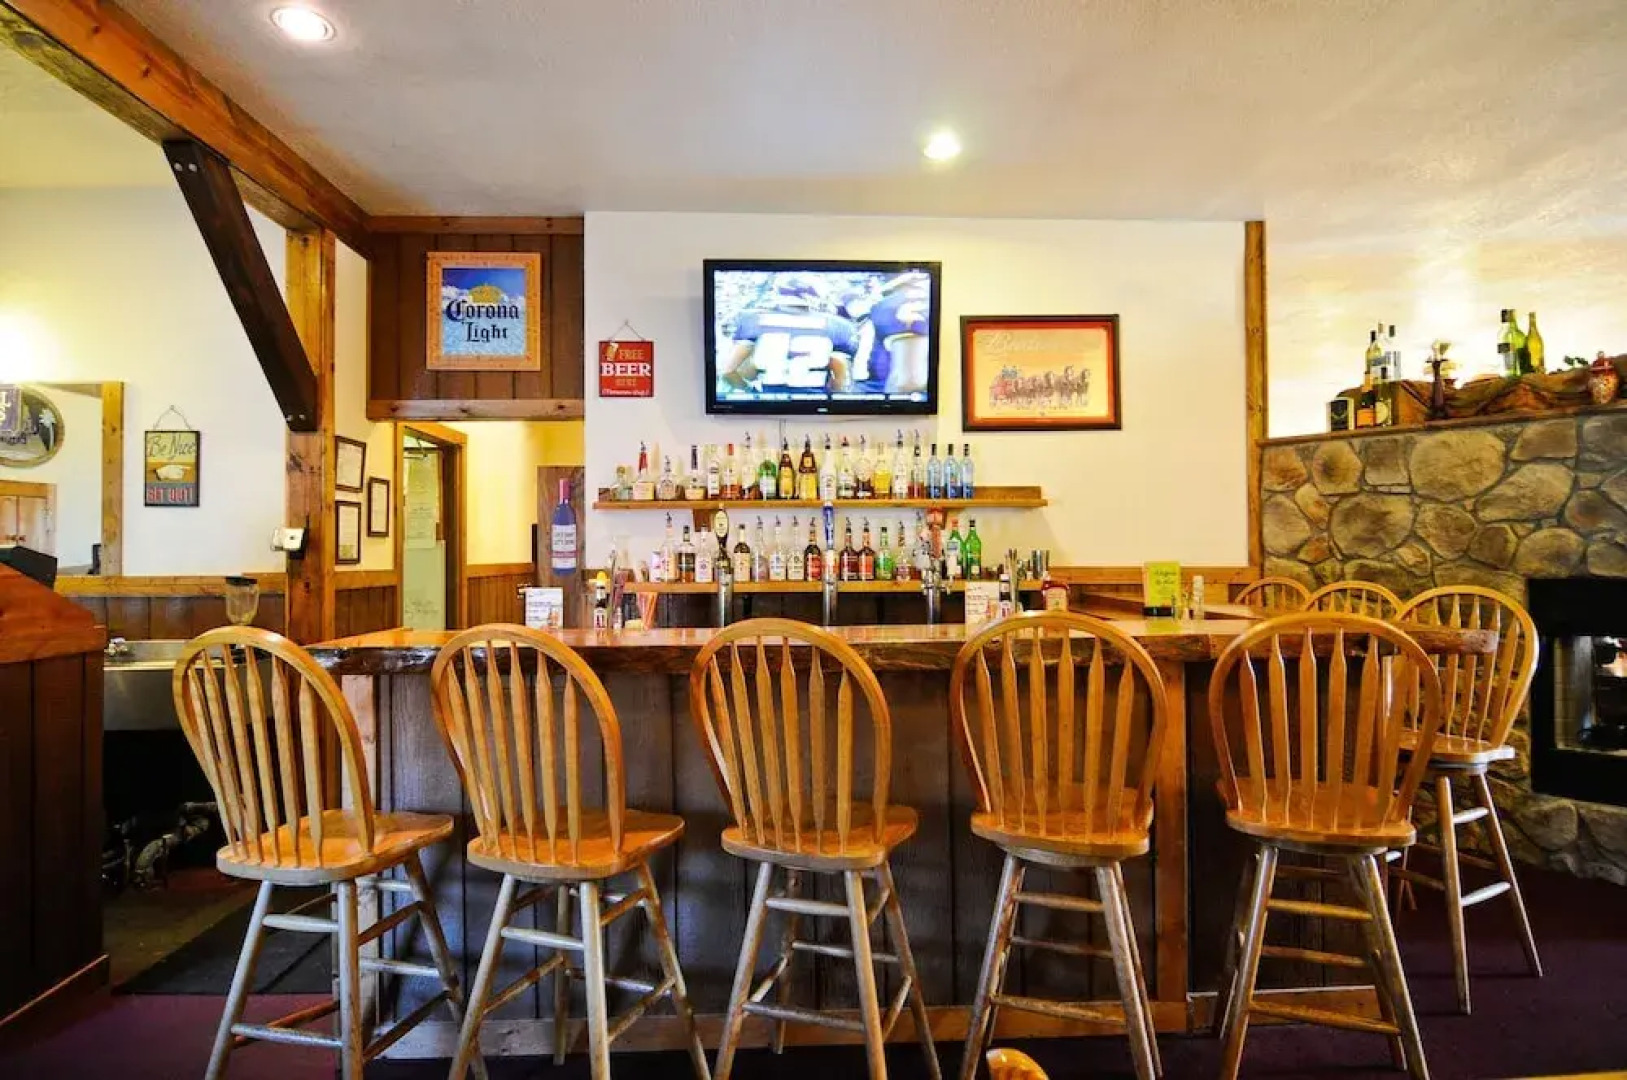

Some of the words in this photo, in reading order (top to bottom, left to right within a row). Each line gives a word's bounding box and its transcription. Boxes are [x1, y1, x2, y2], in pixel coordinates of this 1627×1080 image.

[446, 300, 520, 322] Corona
[462, 321, 508, 343] Light
[601, 362, 652, 376] BEER
[149, 434, 167, 458] Be
[146, 487, 163, 503] GET
